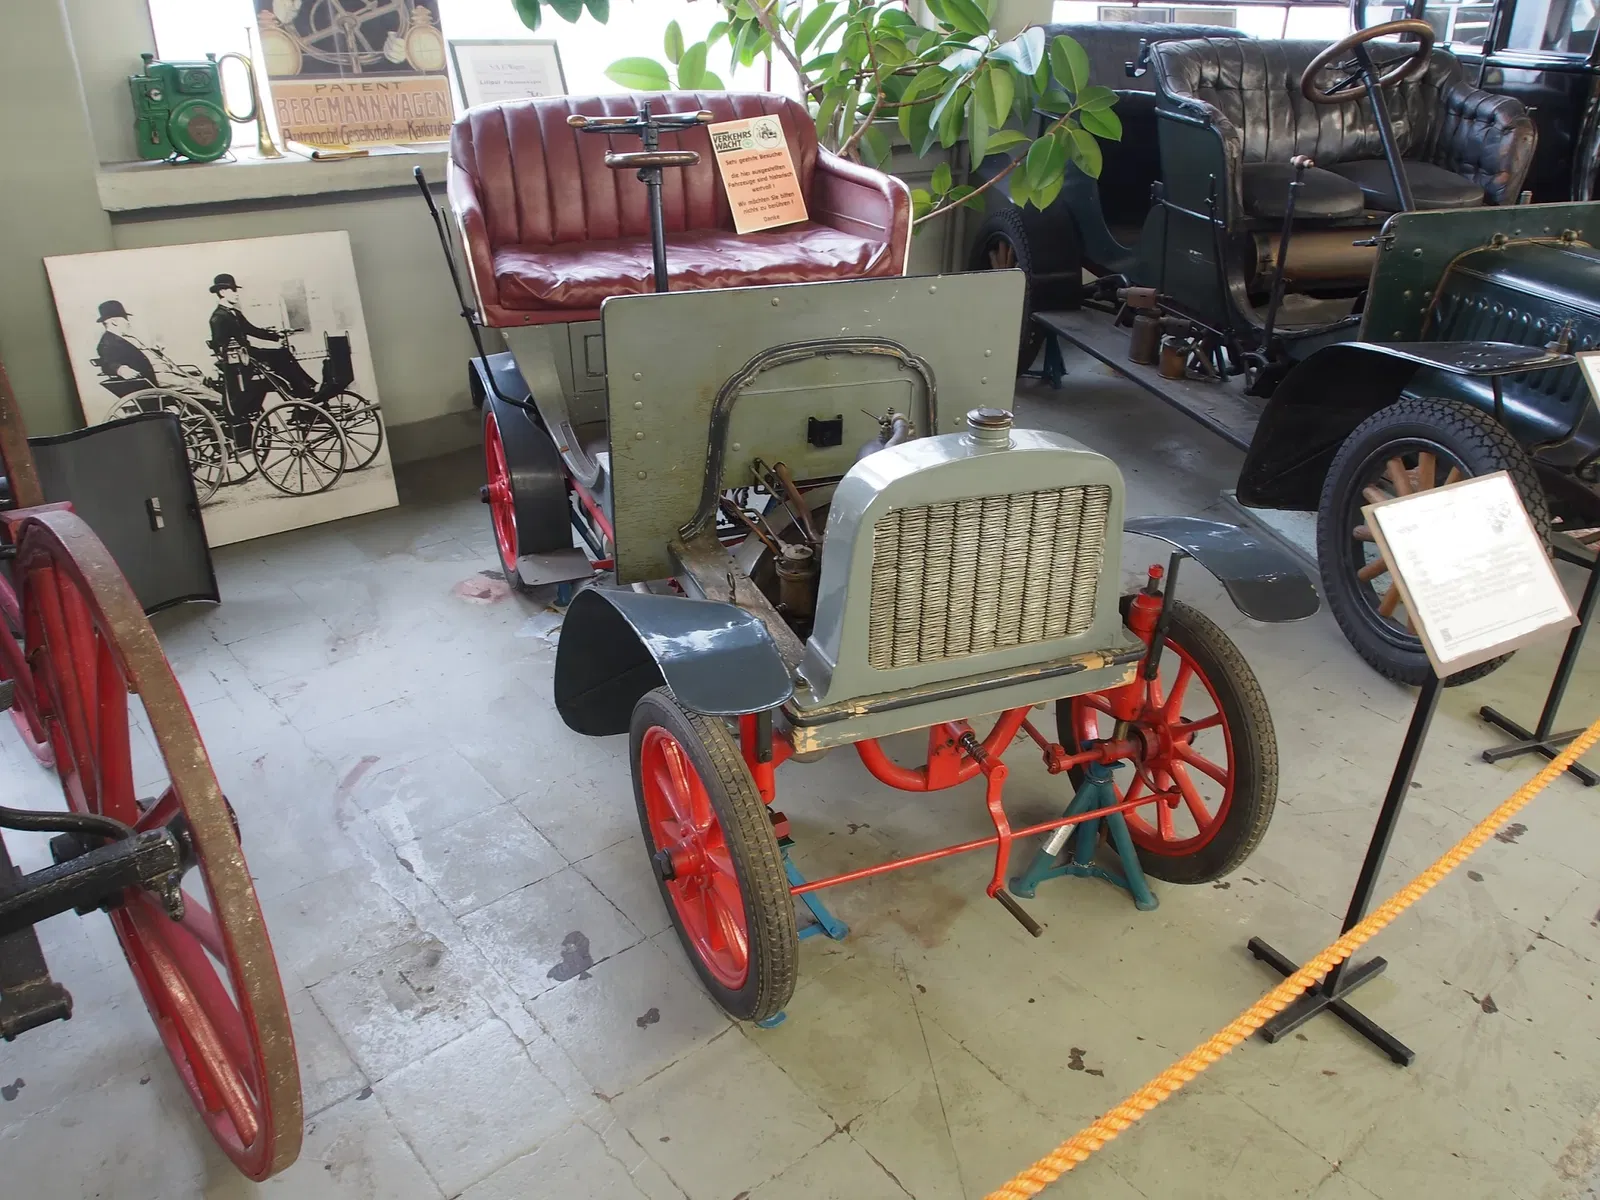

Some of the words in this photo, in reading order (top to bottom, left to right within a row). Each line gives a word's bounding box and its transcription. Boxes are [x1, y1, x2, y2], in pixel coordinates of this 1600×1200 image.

[314, 81, 402, 93] PATENT
[276, 91, 449, 126] BERGMANN-WAGEN
[407, 120, 450, 141] Karlsruhe
[712, 130, 752, 143] VERKEHRS
[715, 139, 742, 150] WACHT
[752, 164, 786, 175] ausgestellten
[728, 179, 756, 188] Fahrzeuge
[757, 175, 768, 183] sind
[769, 171, 794, 181] historisch
[752, 184, 772, 192] wertvoll
[748, 196, 770, 206] möchten
[780, 191, 795, 199] bitten
[768, 200, 791, 209] berühren
[763, 214, 780, 222] Danke
